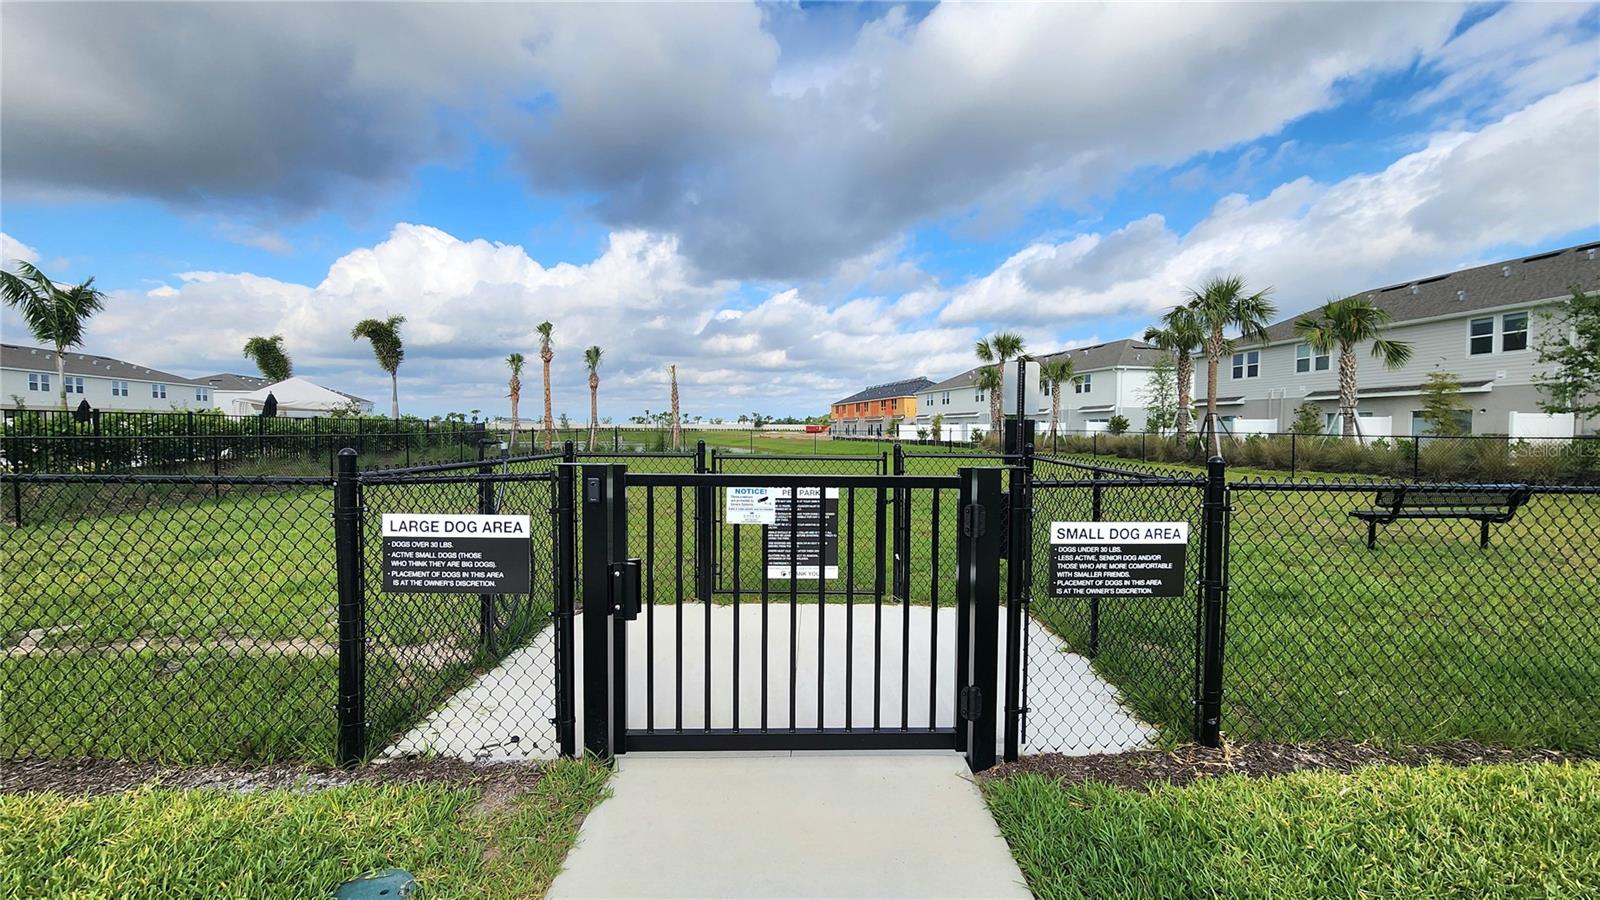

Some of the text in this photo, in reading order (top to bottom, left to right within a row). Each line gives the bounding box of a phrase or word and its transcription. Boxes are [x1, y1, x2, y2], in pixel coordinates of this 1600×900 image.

[390, 520, 523, 533] LARGE DOG AREA
[1057, 528, 1181, 539] SMALL DOG AREA
